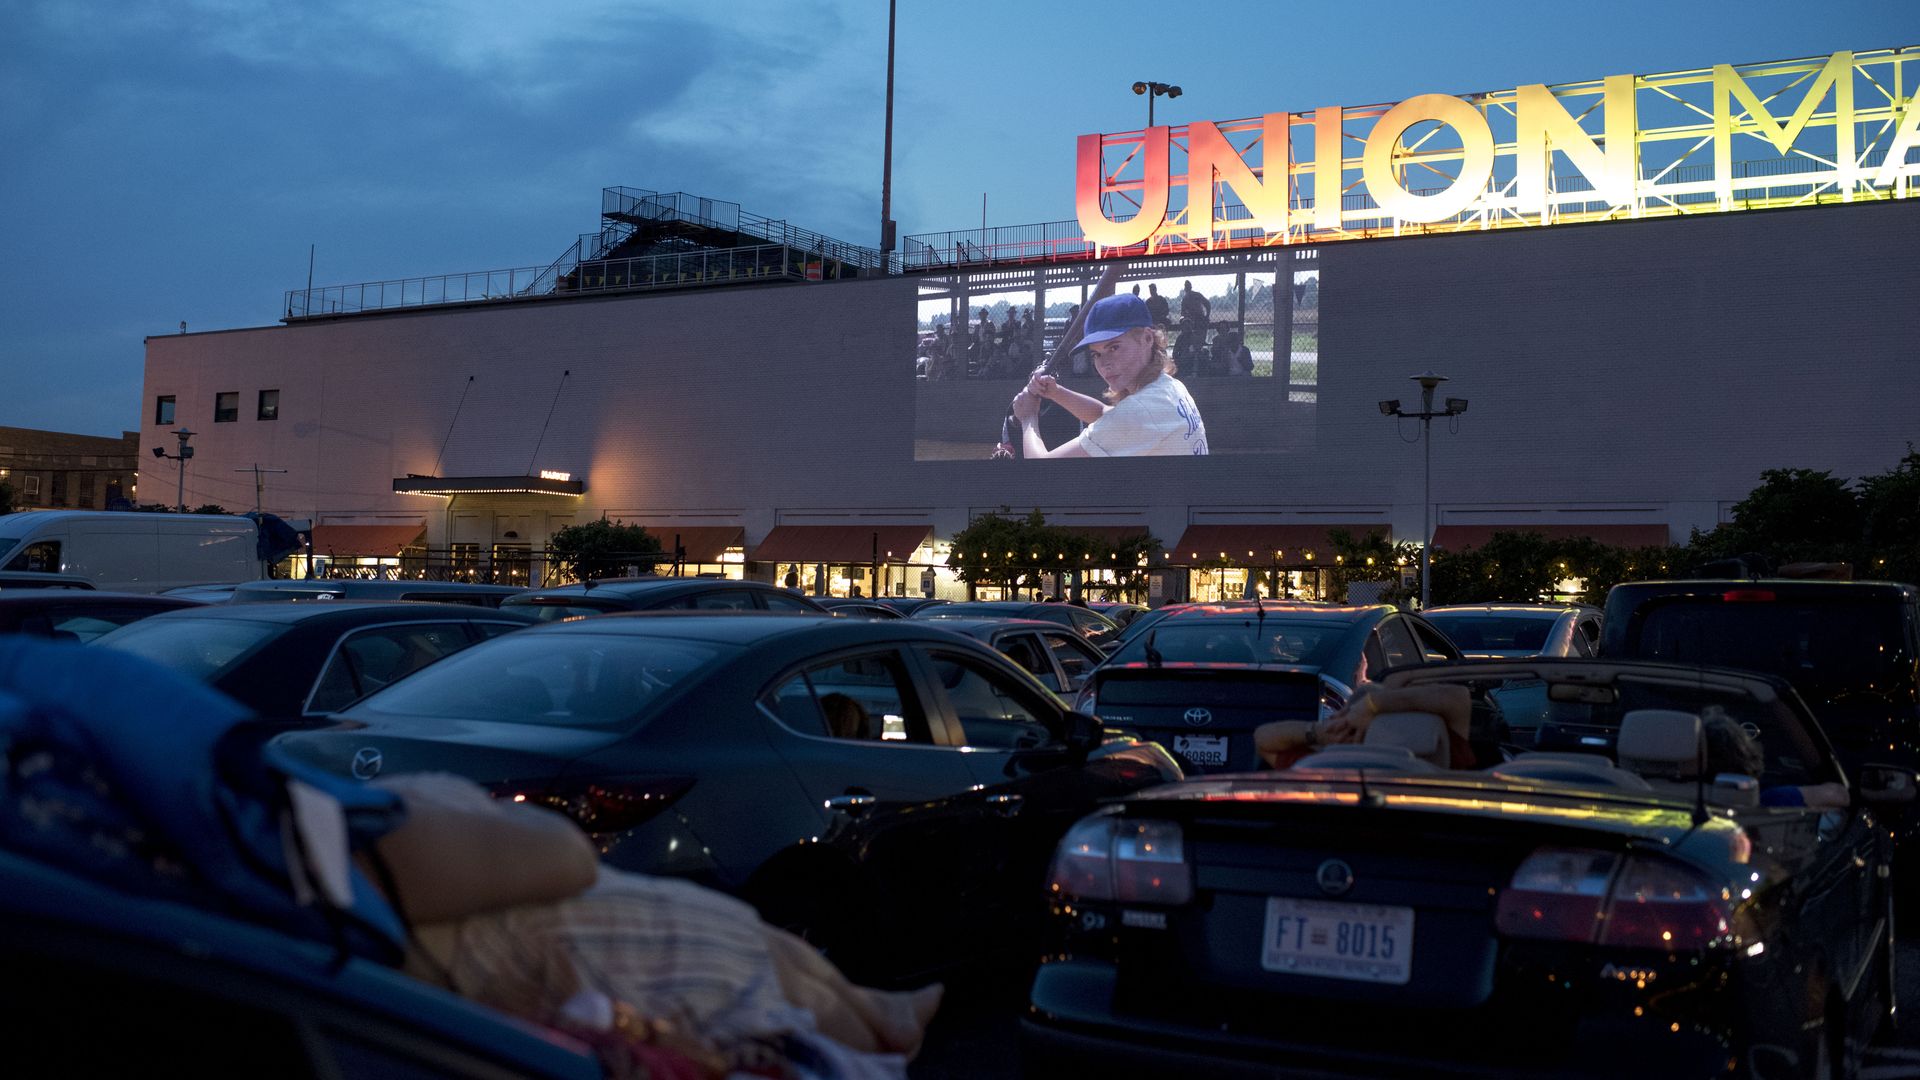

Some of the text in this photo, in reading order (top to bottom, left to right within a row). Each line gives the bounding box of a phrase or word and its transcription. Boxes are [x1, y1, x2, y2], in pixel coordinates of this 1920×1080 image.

[1076, 74, 1634, 248] UNION
[1180, 749, 1221, 763] 6089R
[1276, 915, 1395, 960] FT 8015
